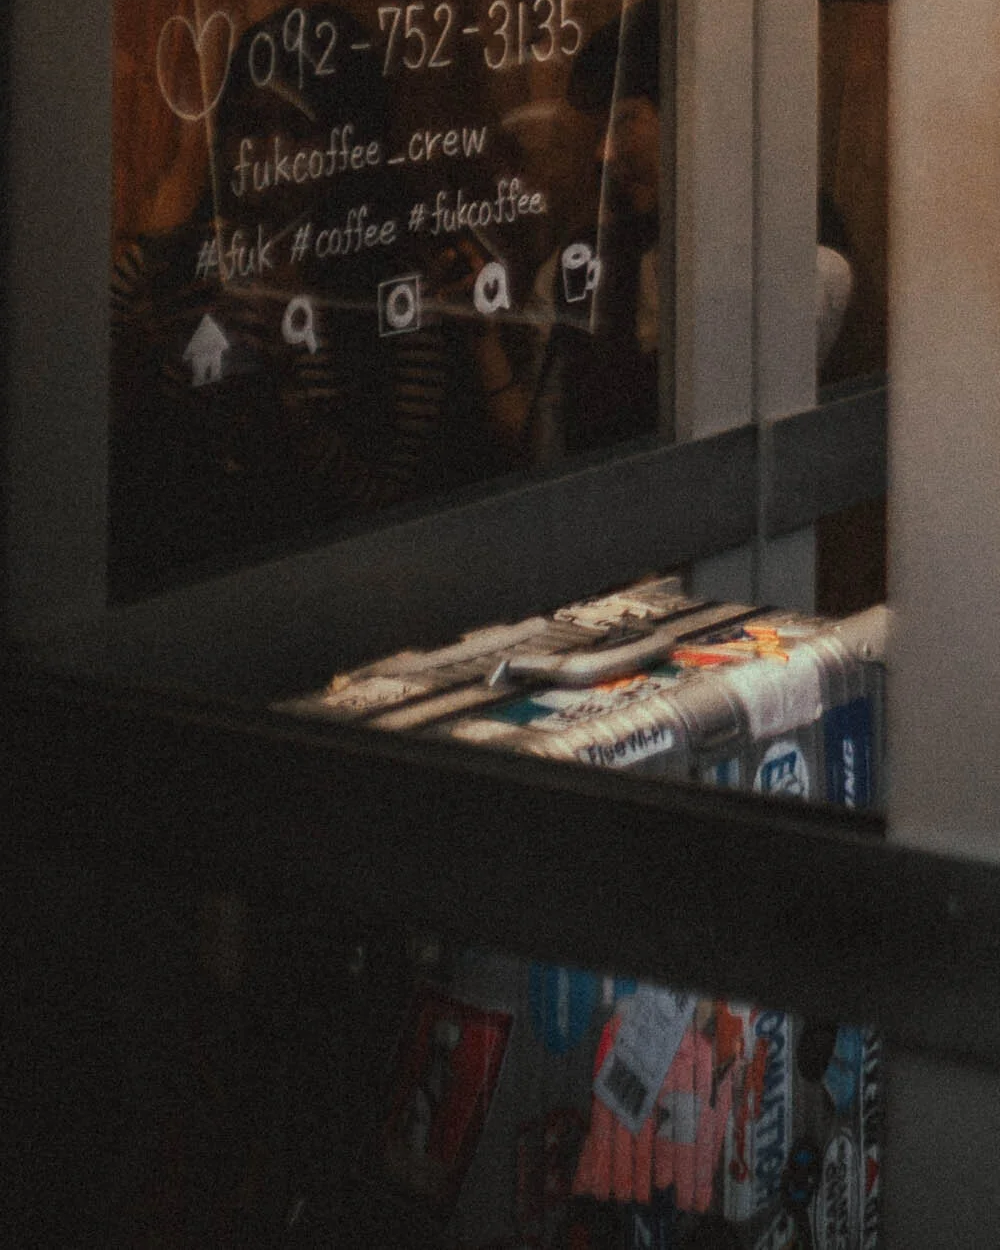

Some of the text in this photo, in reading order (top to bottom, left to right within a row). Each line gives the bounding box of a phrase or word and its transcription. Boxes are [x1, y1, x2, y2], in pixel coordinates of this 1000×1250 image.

[230, 124, 488, 197] fukcoffee_crew
[194, 177, 547, 279] #fuk #coffee #fukcoffee
